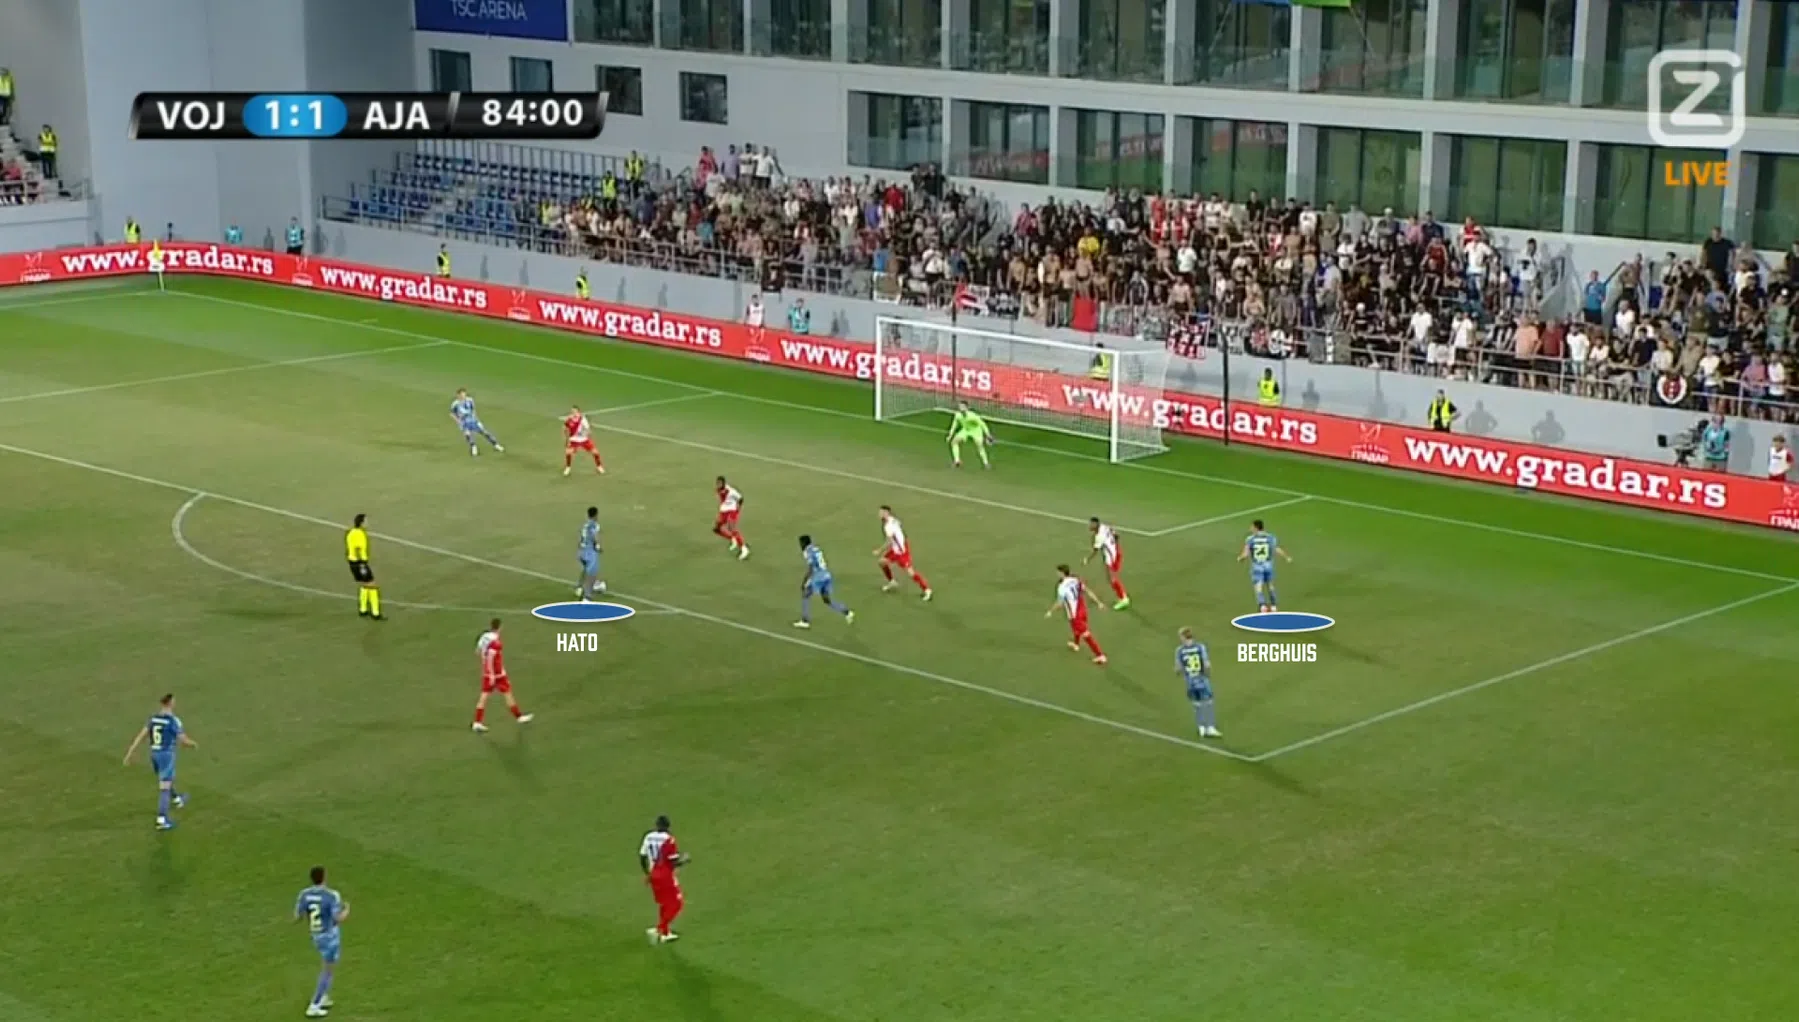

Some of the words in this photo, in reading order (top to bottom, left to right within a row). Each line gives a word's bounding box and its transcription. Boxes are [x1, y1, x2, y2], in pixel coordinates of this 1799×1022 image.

[478, 0, 529, 21] ARENA
[62, 246, 274, 274] www.gradar.rs
[320, 265, 487, 308] www.gradar.rs
[539, 300, 722, 347] www.gradar.rs
[780, 339, 993, 390] www.gradar.rs
[1404, 436, 1727, 508] www.gradar.rs
